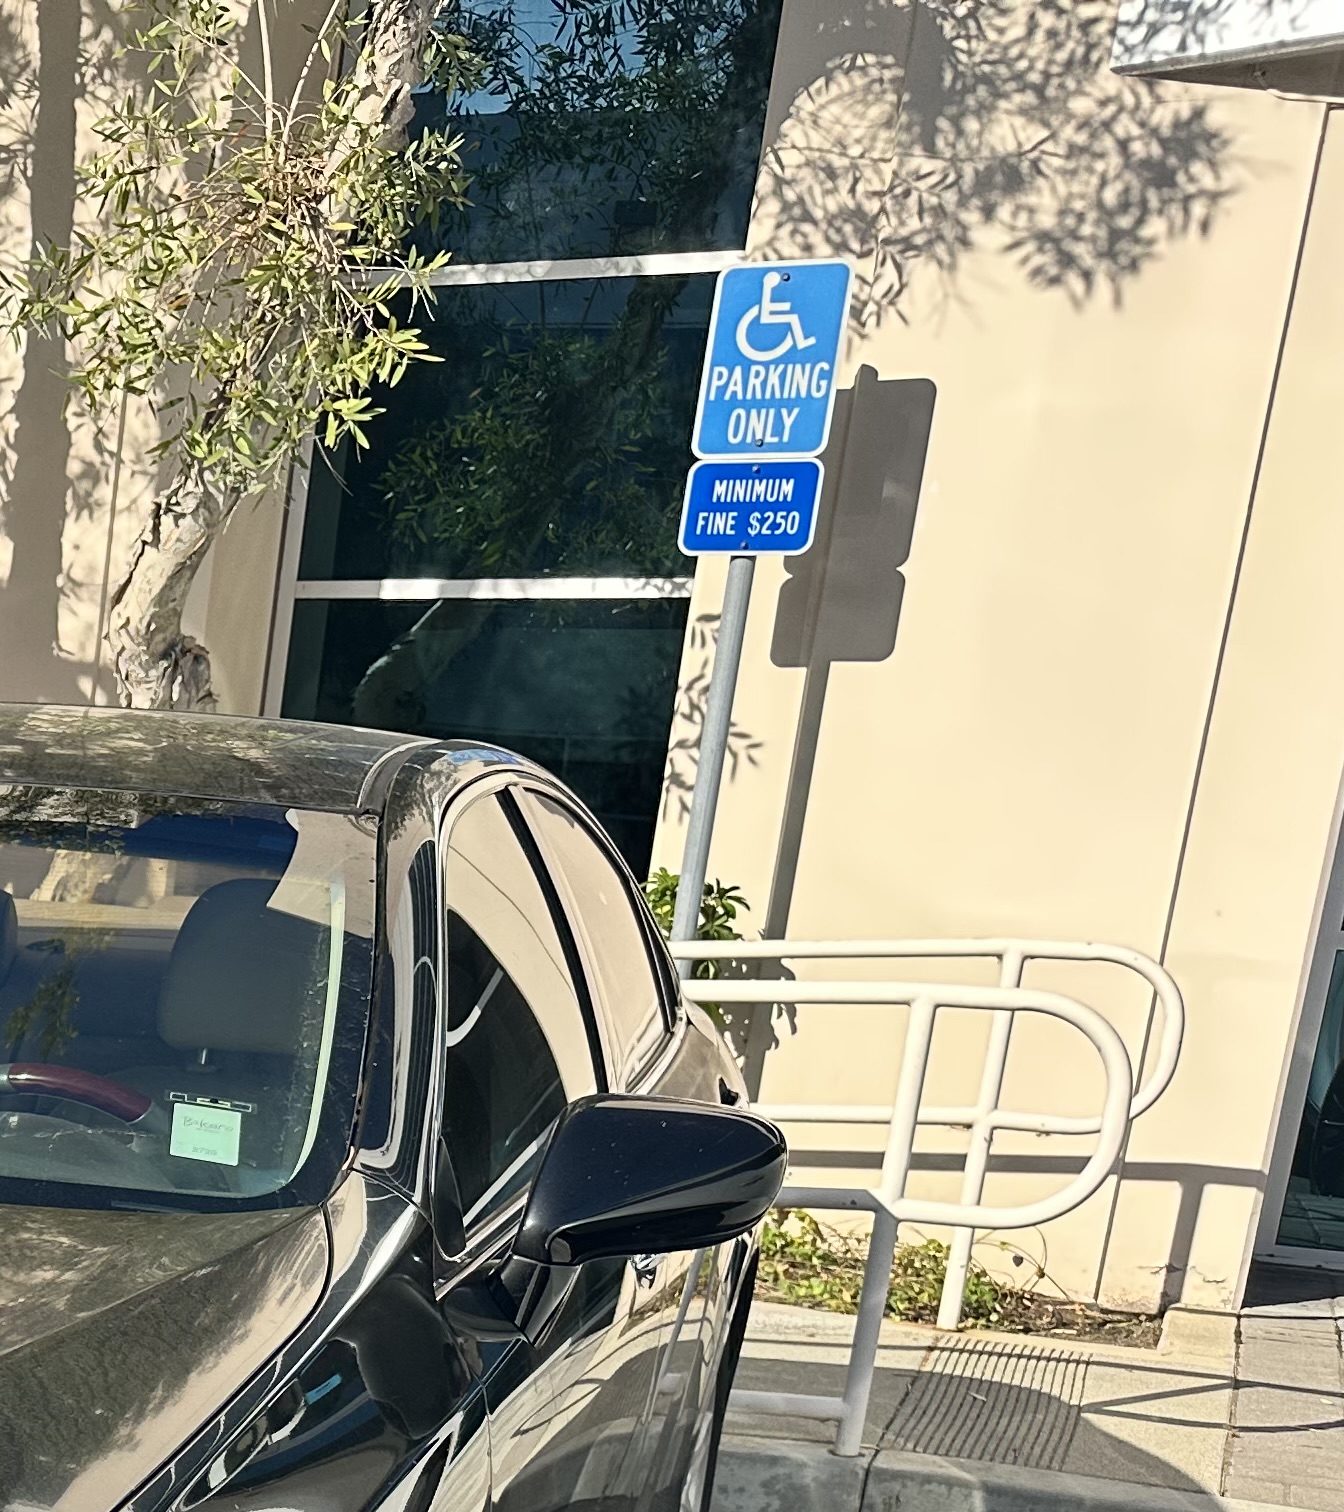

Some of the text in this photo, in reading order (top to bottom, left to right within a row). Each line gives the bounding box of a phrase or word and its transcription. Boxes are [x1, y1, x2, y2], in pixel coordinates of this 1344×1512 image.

[708, 361, 830, 401] PARKING
[727, 407, 800, 444] ONLY
[712, 478, 795, 503] MINIMUM
[696, 511, 800, 537] FINE $250
